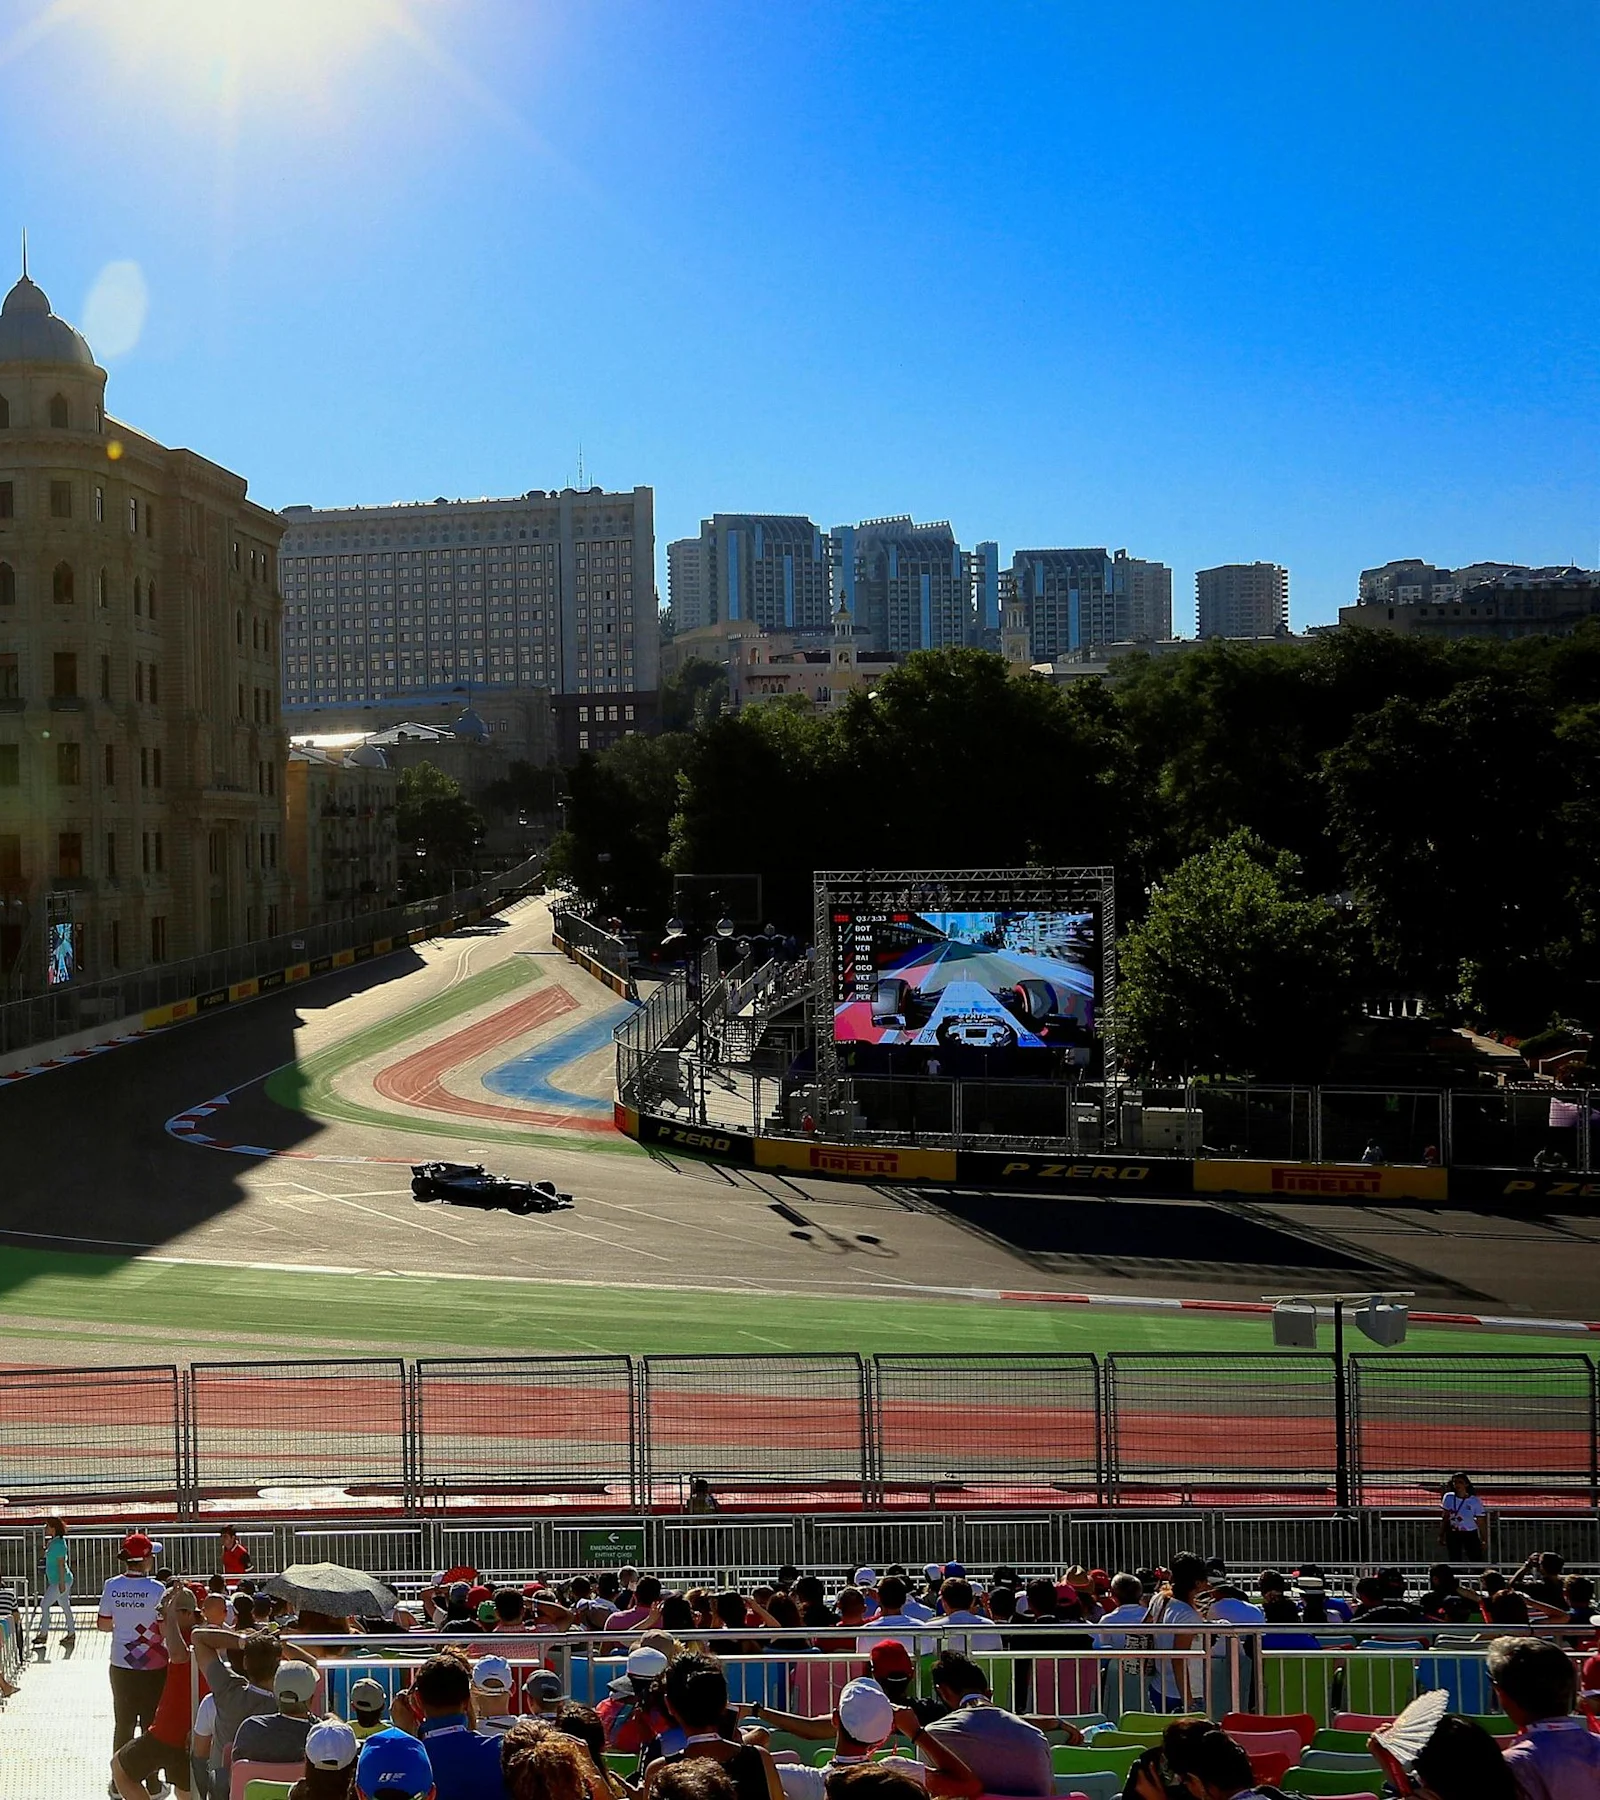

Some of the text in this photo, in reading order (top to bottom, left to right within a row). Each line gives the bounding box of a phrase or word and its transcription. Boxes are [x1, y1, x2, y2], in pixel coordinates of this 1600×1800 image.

[657, 1126, 732, 1152] P ZERO
[810, 1148, 898, 1172] PIRELLI
[1002, 1162, 1150, 1180] P ZERO
[1272, 1168, 1382, 1193] PIRELLI
[1502, 1181, 1536, 1195] P
[112, 1590, 149, 1598] Customer
[115, 1600, 145, 1608] Service
